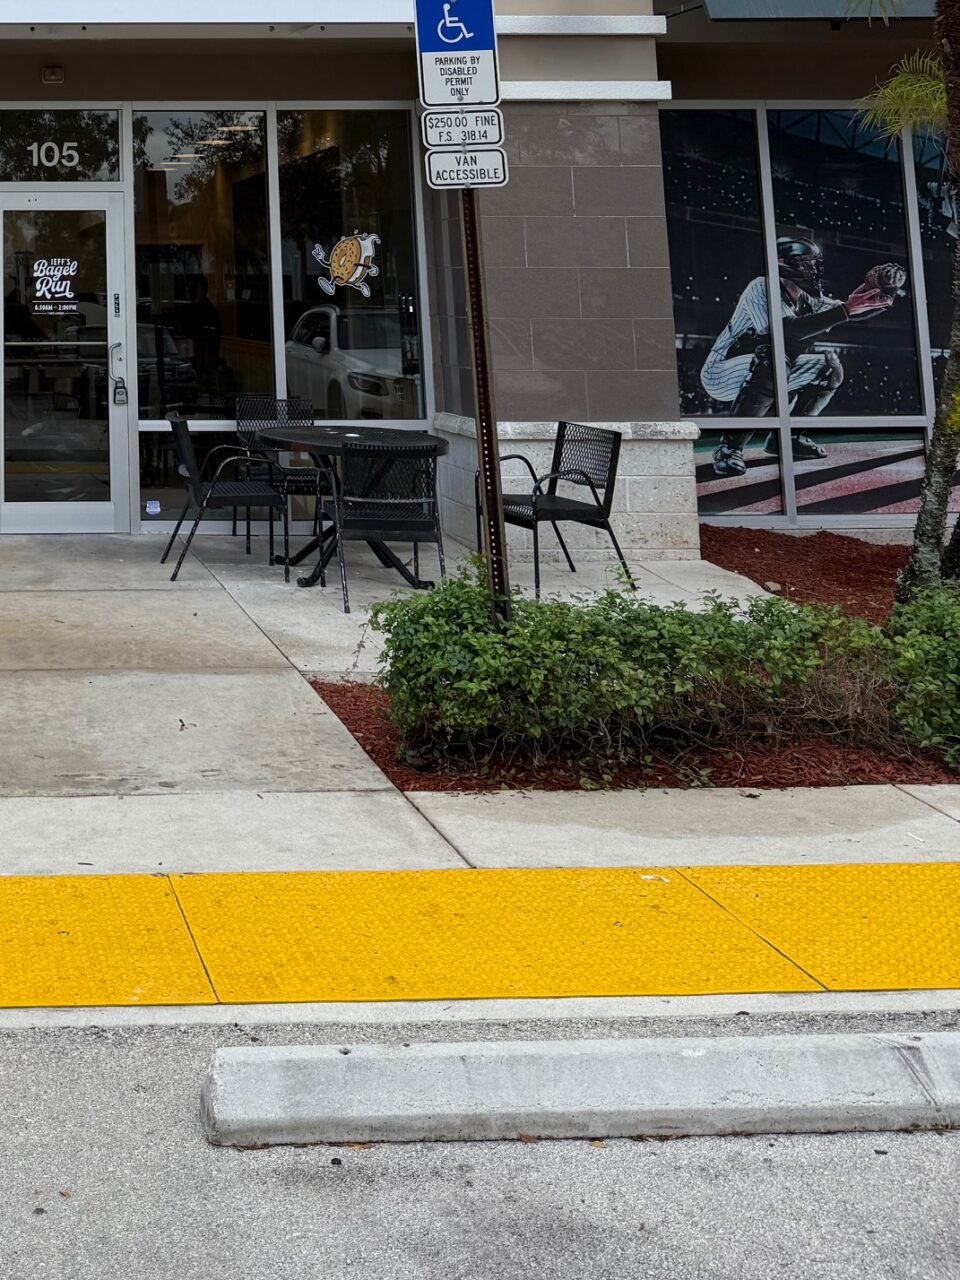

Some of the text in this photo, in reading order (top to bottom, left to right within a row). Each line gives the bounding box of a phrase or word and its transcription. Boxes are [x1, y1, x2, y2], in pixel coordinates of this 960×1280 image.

[434, 55, 481, 66] PARKING BY
[440, 66, 478, 76] DISABLED
[445, 77, 473, 86] PERMIT
[450, 87, 470, 97] ONLY
[428, 115, 497, 130] $250.00 FINE
[438, 130, 488, 142] F.S. 318.14
[27, 141, 80, 168] 105
[455, 155, 478, 167] VAN
[435, 167, 501, 181] ACCESSIBLE
[33, 259, 78, 281] Bagel
[35, 276, 74, 300] Run
